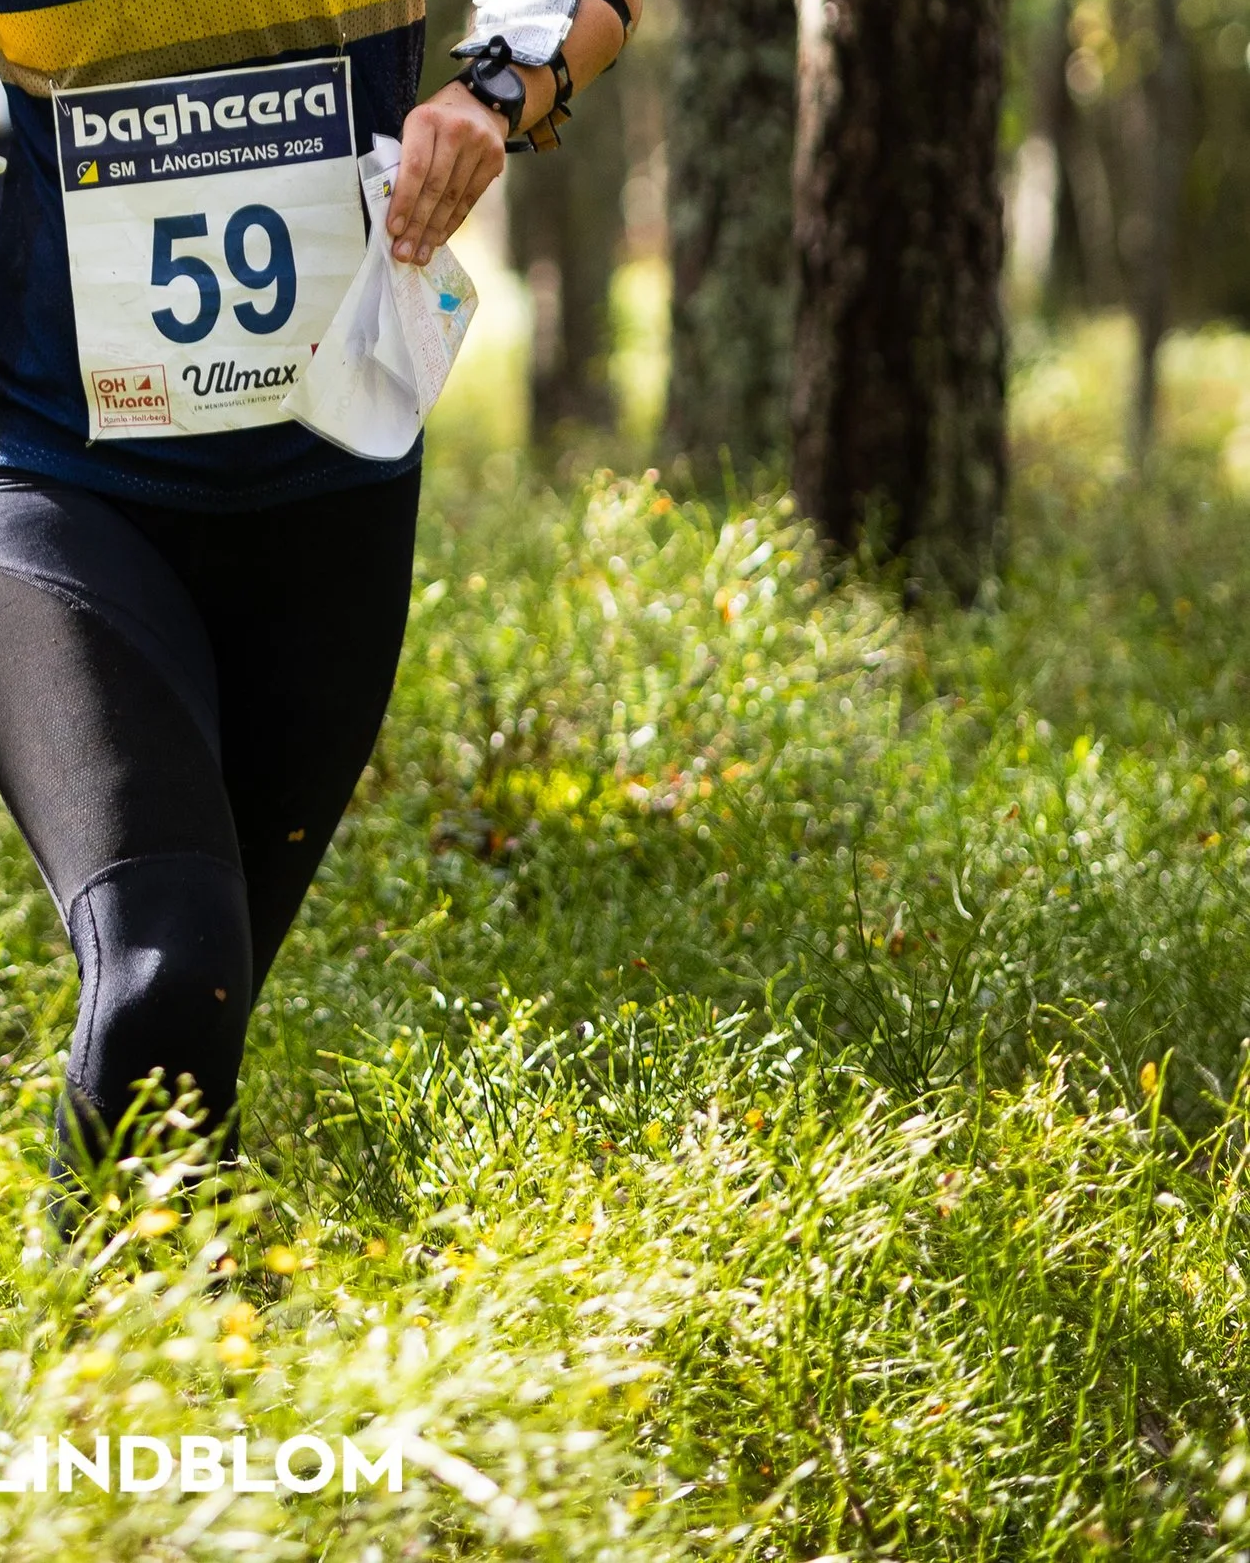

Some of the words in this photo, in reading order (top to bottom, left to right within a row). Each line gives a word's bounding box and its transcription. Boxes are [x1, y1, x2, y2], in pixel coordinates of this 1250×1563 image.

[73, 81, 338, 148] bagheera
[109, 160, 136, 179] SM
[150, 143, 279, 174] LÅNGDISTANS
[283, 137, 324, 158] 2025
[150, 203, 297, 344] 59
[182, 360, 297, 396] Ullmax
[100, 394, 166, 410] Tisaren
